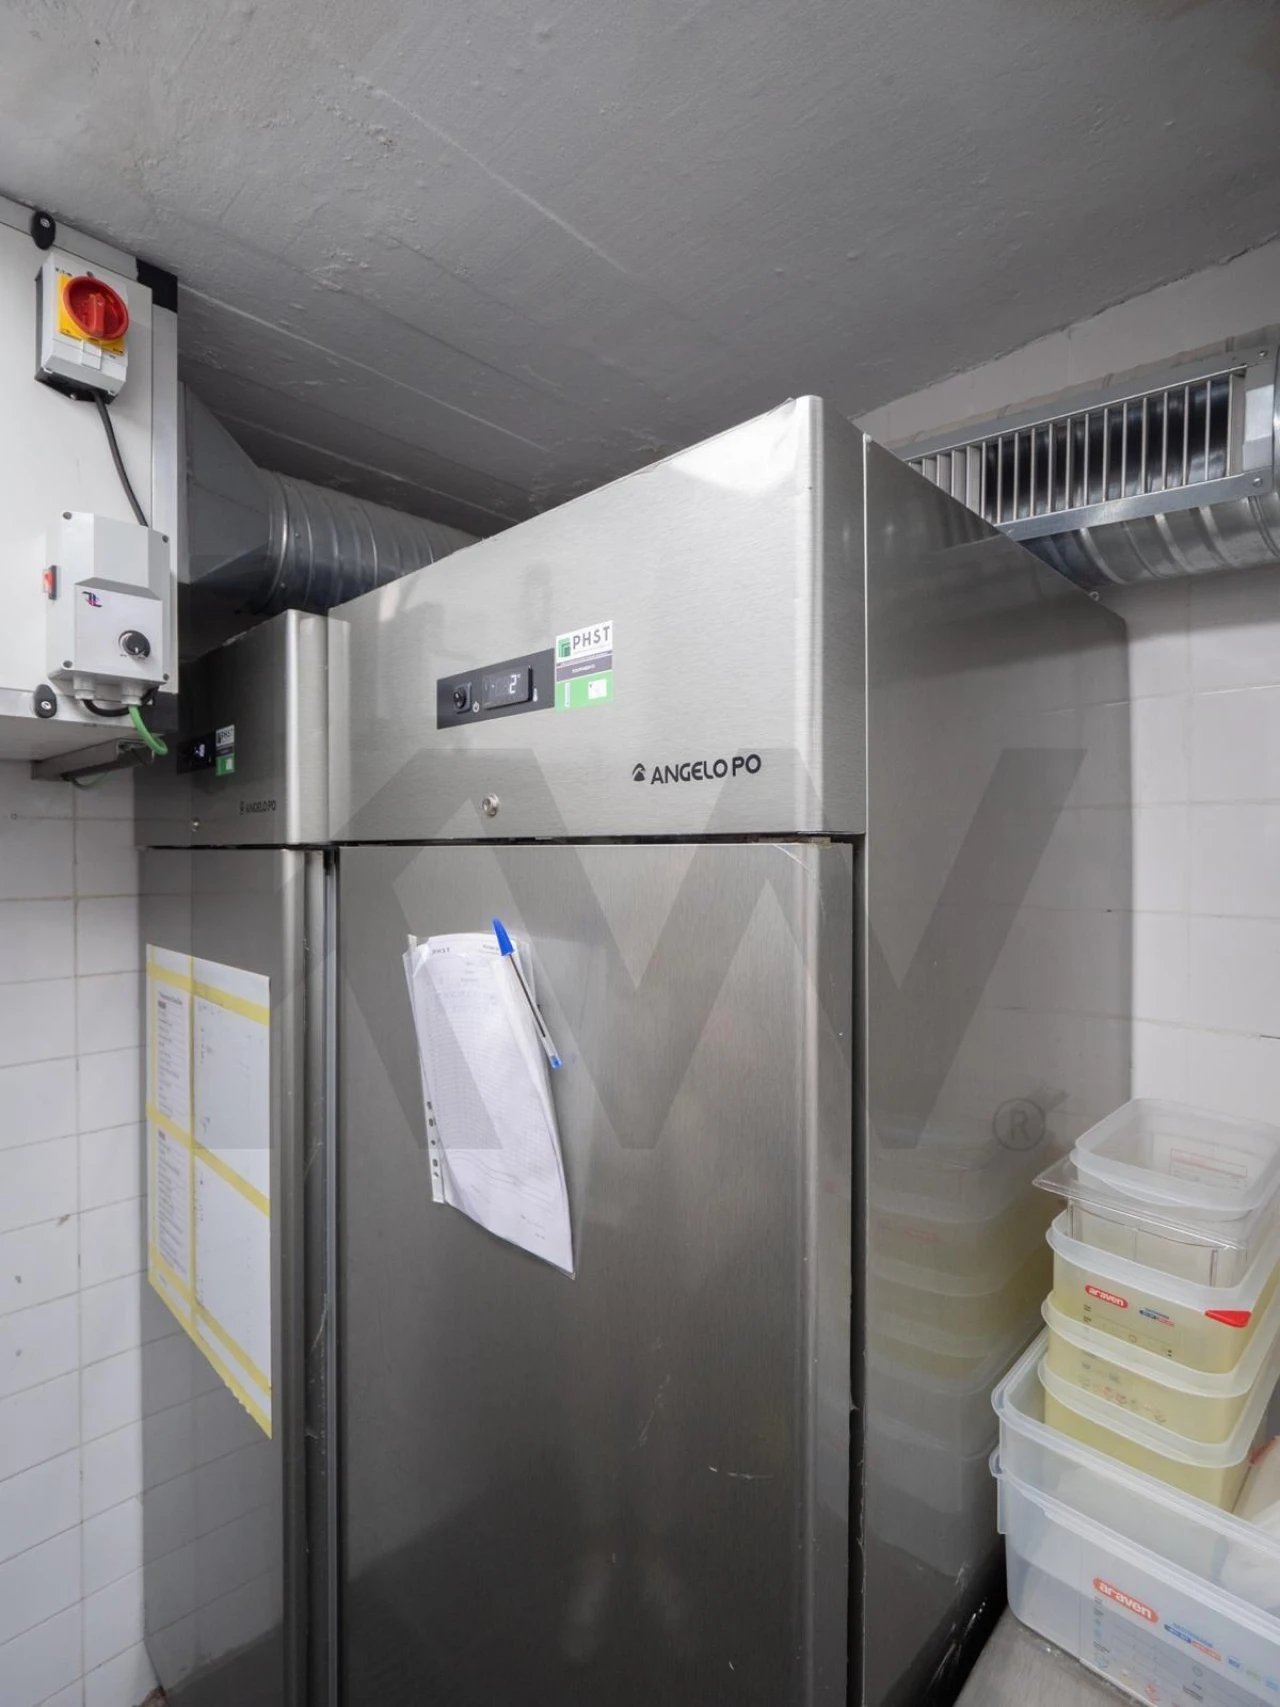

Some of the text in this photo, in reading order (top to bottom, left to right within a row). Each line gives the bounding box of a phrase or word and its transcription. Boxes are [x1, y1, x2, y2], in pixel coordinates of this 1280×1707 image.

[573, 625, 610, 649] PHST
[650, 753, 762, 785] ANGELO PO
[1088, 1287, 1124, 1307] araven
[1099, 1581, 1152, 1619] araven
